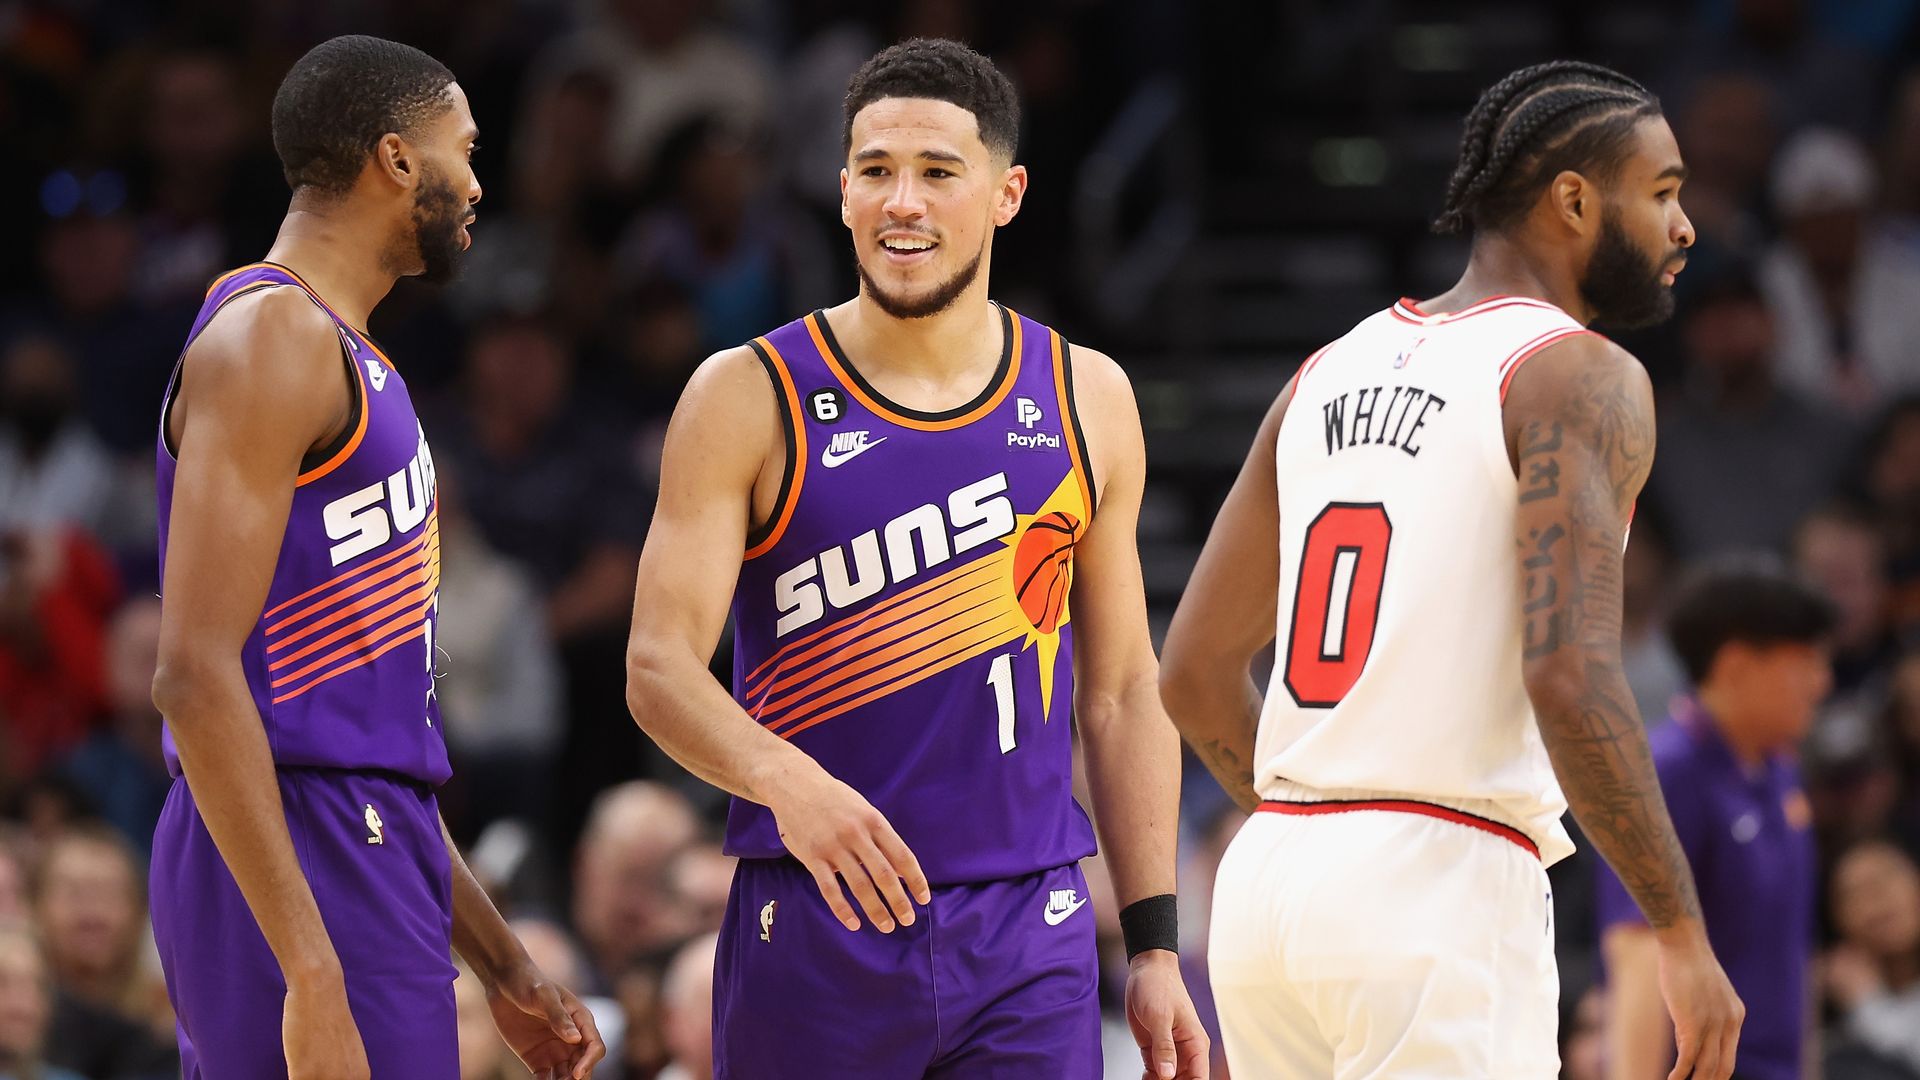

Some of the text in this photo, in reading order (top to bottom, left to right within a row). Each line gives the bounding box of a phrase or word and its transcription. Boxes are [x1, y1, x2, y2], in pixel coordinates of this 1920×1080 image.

[813, 392, 839, 421] 6
[1322, 385, 1446, 458] WHITE
[830, 430, 870, 453] NIKE
[1007, 432, 1060, 449] PayPal
[1283, 501, 1393, 709] 0
[986, 652, 1018, 755] 1
[1049, 888, 1077, 911] NIKE
